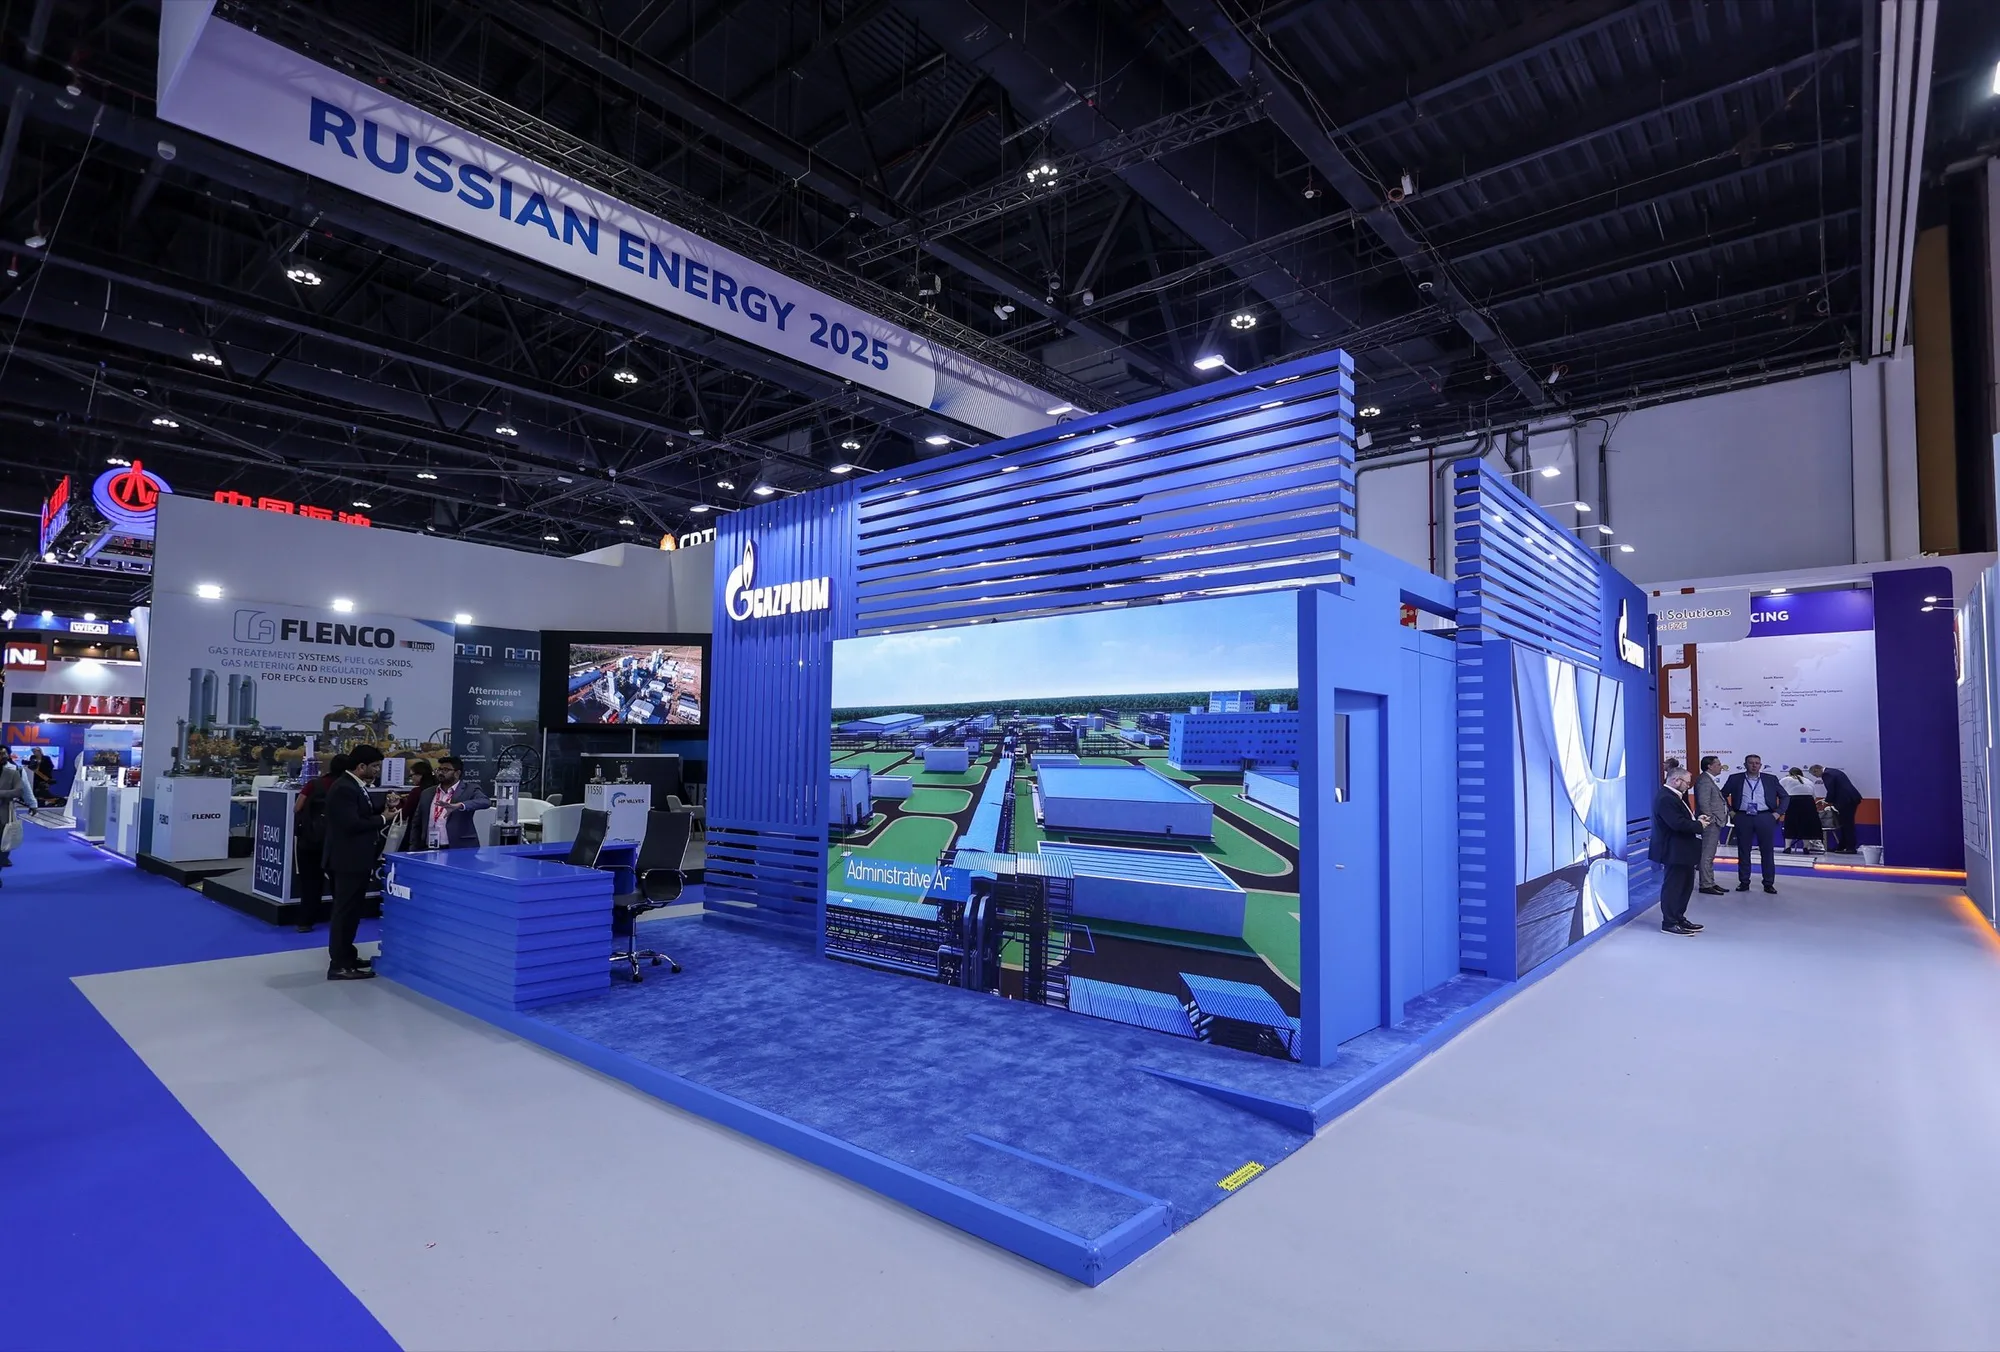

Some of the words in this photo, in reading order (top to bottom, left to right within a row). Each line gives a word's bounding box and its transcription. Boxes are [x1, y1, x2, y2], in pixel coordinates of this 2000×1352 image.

[309, 96, 599, 256] RUSSIAN
[618, 229, 796, 332] ENERGY
[809, 313, 889, 371] 2025
[753, 576, 829, 619] GAZPROM
[1667, 608, 1731, 620] Solutions
[73, 624, 104, 633] WIKA
[281, 619, 395, 649] FLENCO
[208, 646, 229, 655] GAS
[231, 647, 296, 660] TREATEMENT
[298, 653, 342, 664] SYSTEMS,
[344, 656, 366, 665] FUEL
[367, 657, 385, 666] GAS
[386, 658, 413, 669] SKIDS,
[221, 658, 241, 667] GAS
[243, 660, 295, 671] METERING
[296, 663, 318, 672] AND
[320, 665, 376, 676] REGULATION
[377, 668, 403, 677] SKIDS
[261, 672, 282, 681] FOR
[283, 674, 306, 683] EPCs
[308, 674, 316, 683] &
[318, 675, 338, 684] END
[340, 677, 369, 686] USERS
[468, 686, 522, 697] Aftermarket
[475, 697, 514, 707] Services
[7, 725, 50, 744] NL
[847, 860, 931, 889] Administrative
[933, 869, 951, 891] Ar
